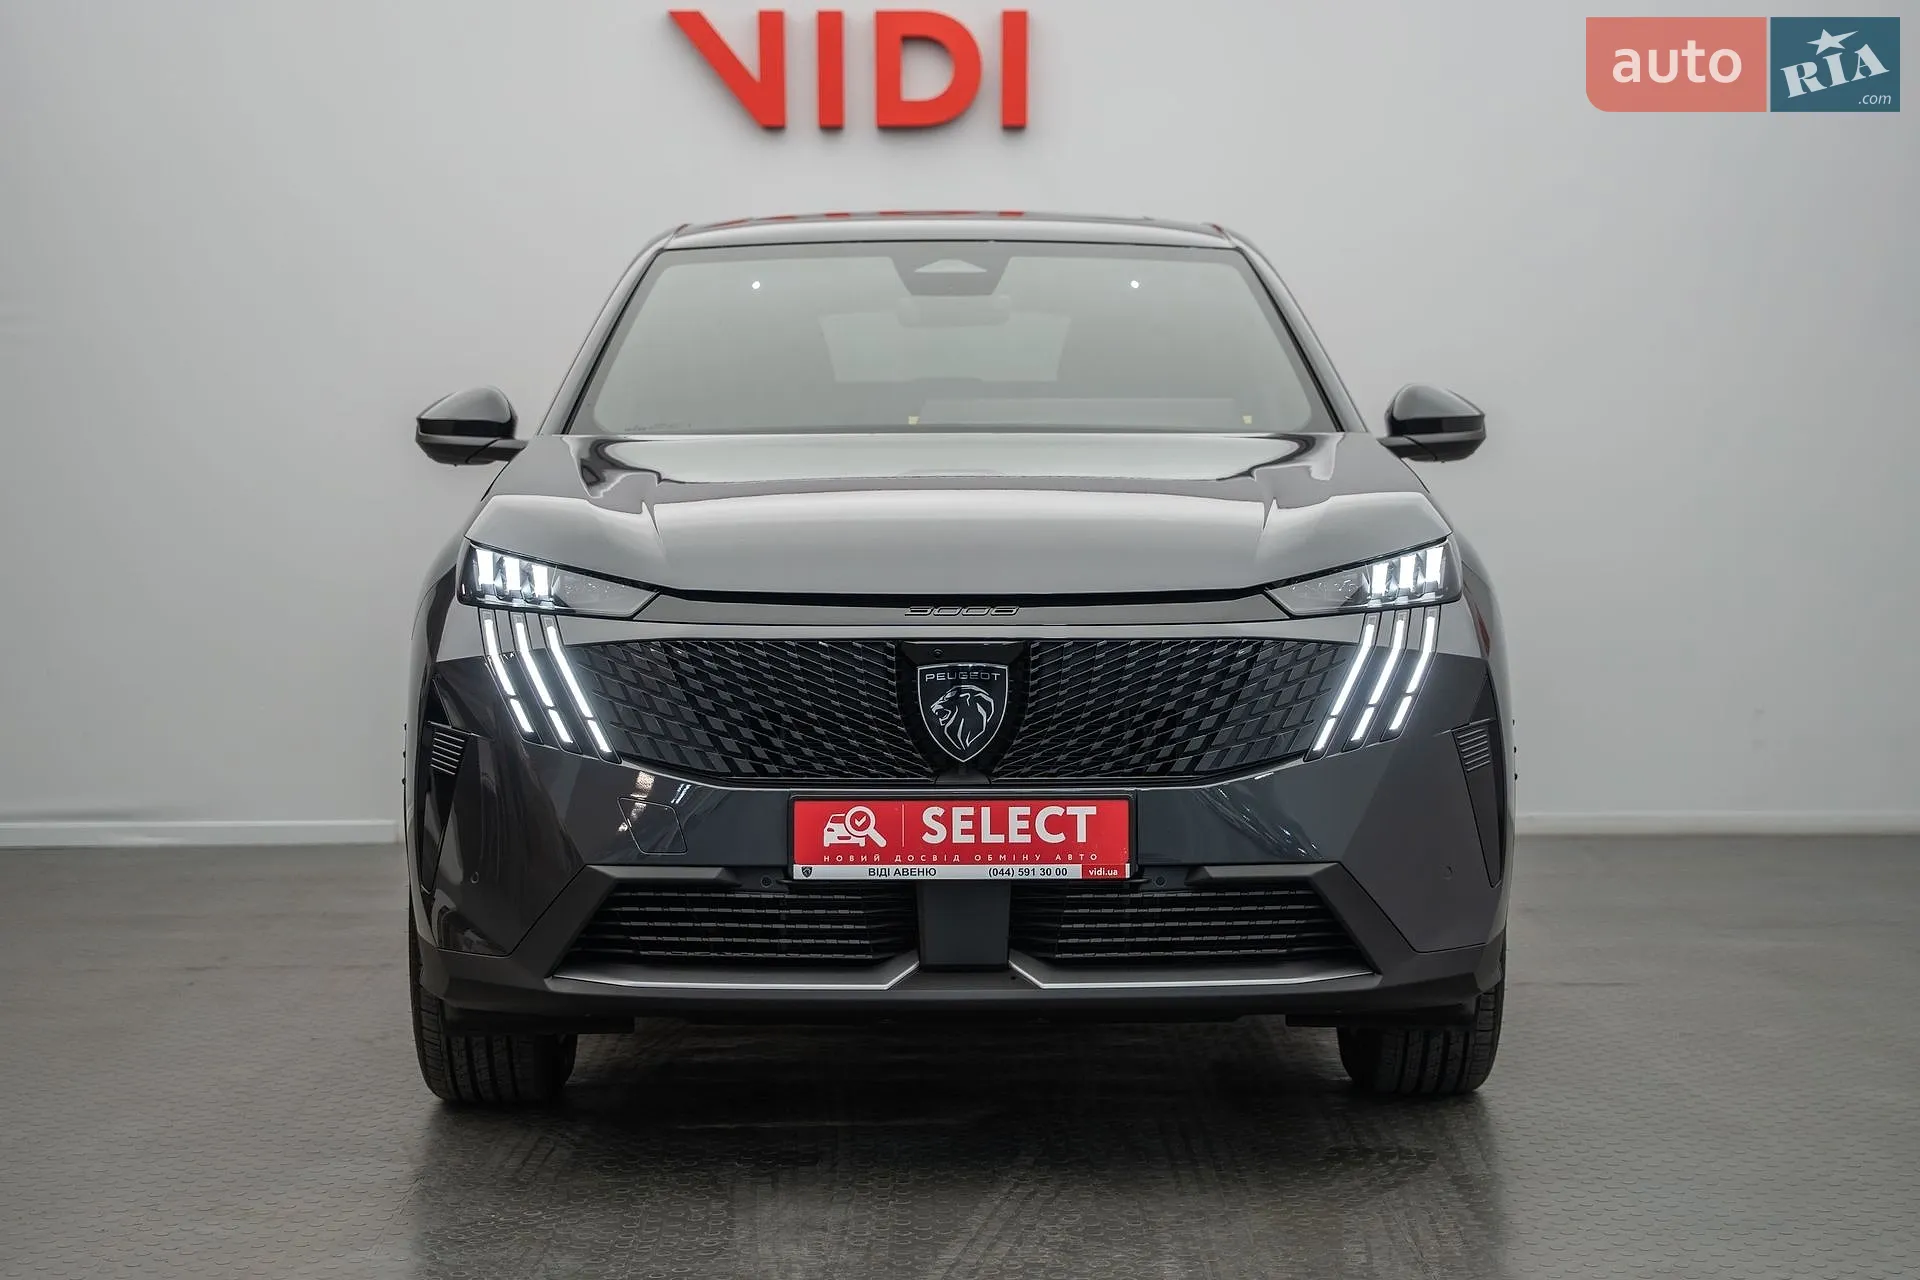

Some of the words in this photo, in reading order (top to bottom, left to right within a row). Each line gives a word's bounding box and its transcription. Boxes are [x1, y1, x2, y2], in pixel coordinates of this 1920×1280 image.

[668, 10, 1029, 130] VIDI
[925, 671, 1001, 682] PEUGEOT
[922, 805, 1097, 844] SELECT
[823, 853, 881, 862] НОВИЙ
[894, 854, 961, 862] ДОСВІД
[1055, 853, 1098, 861] АВТО
[868, 867, 890, 878] ВІДІ
[893, 867, 937, 877] АВЕНЮ
[988, 867, 1015, 878] (044)
[1018, 867, 1036, 877] 591
[1039, 867, 1052, 877] 30
[1055, 867, 1068, 877] 00
[1088, 867, 1118, 876] vidi.ua
